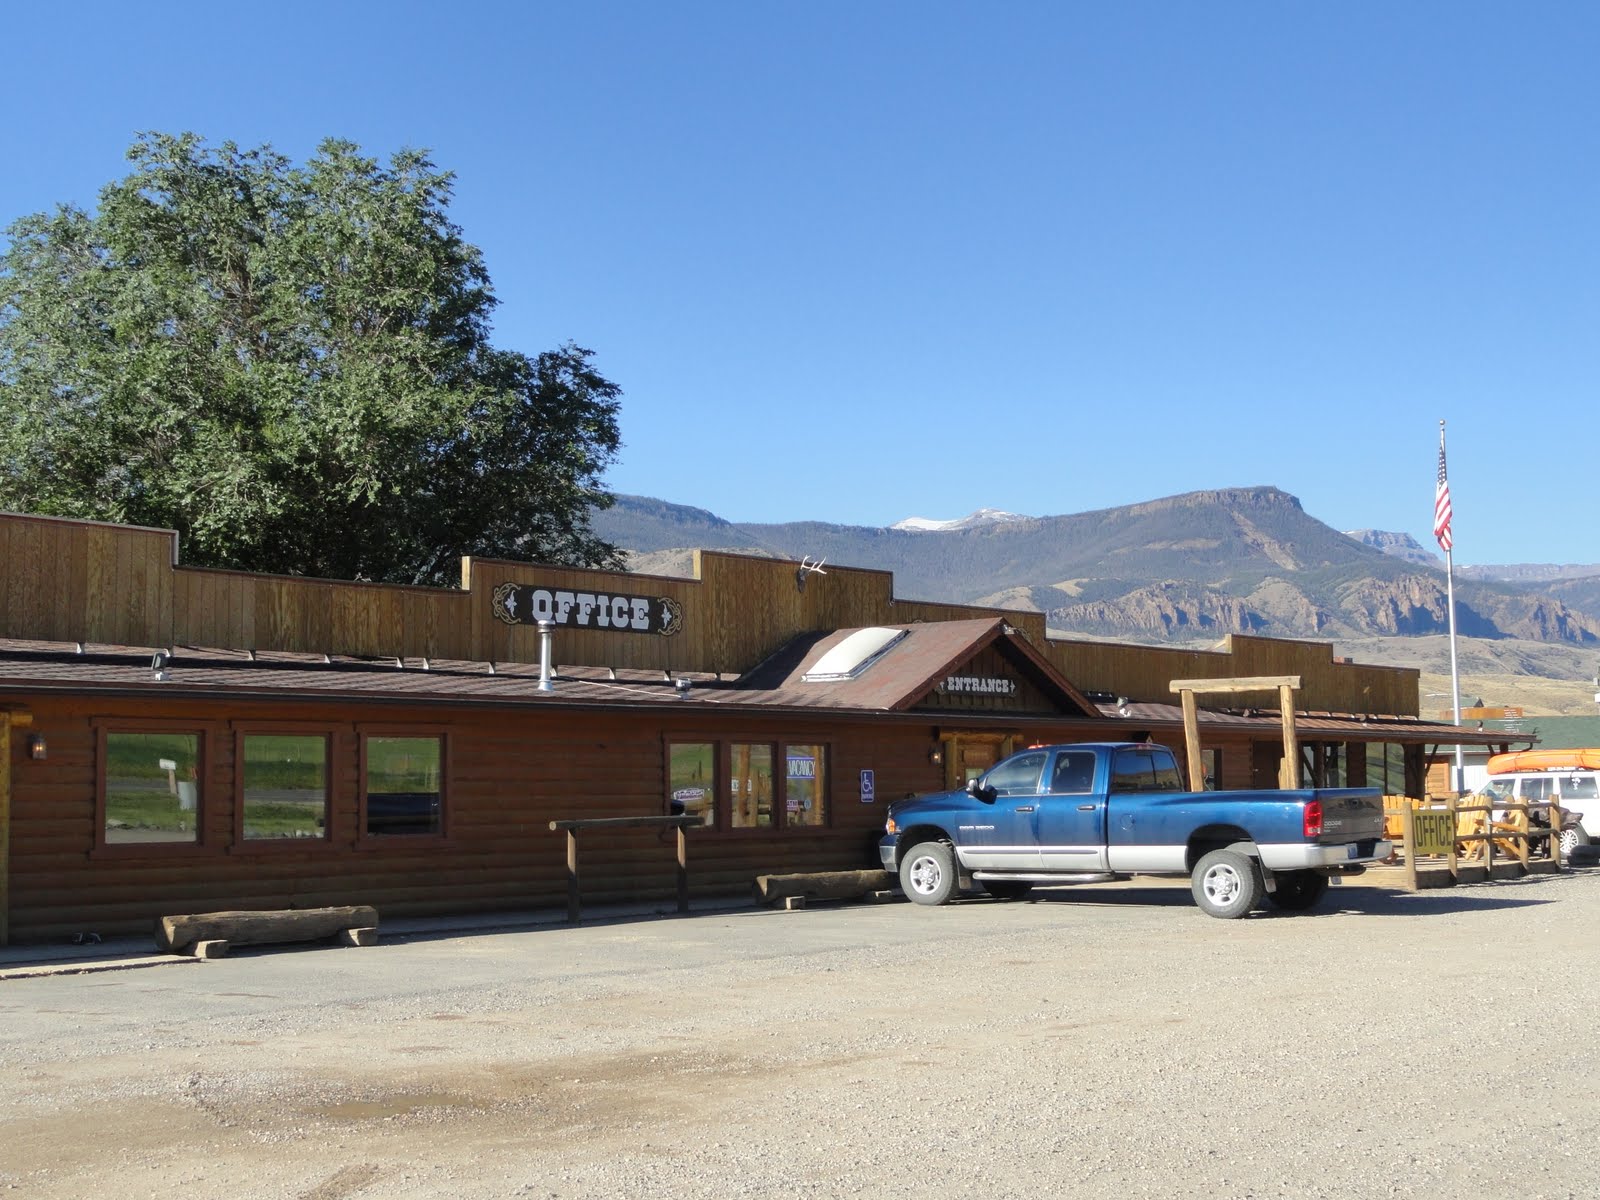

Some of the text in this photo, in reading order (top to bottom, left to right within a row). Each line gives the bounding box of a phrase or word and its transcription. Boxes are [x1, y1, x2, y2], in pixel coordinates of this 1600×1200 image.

[531, 589, 650, 630] OFFICE
[947, 676, 1009, 693] ENTRANCE
[788, 760, 816, 776] VACANCY
[1415, 815, 1452, 847] OFFICE
